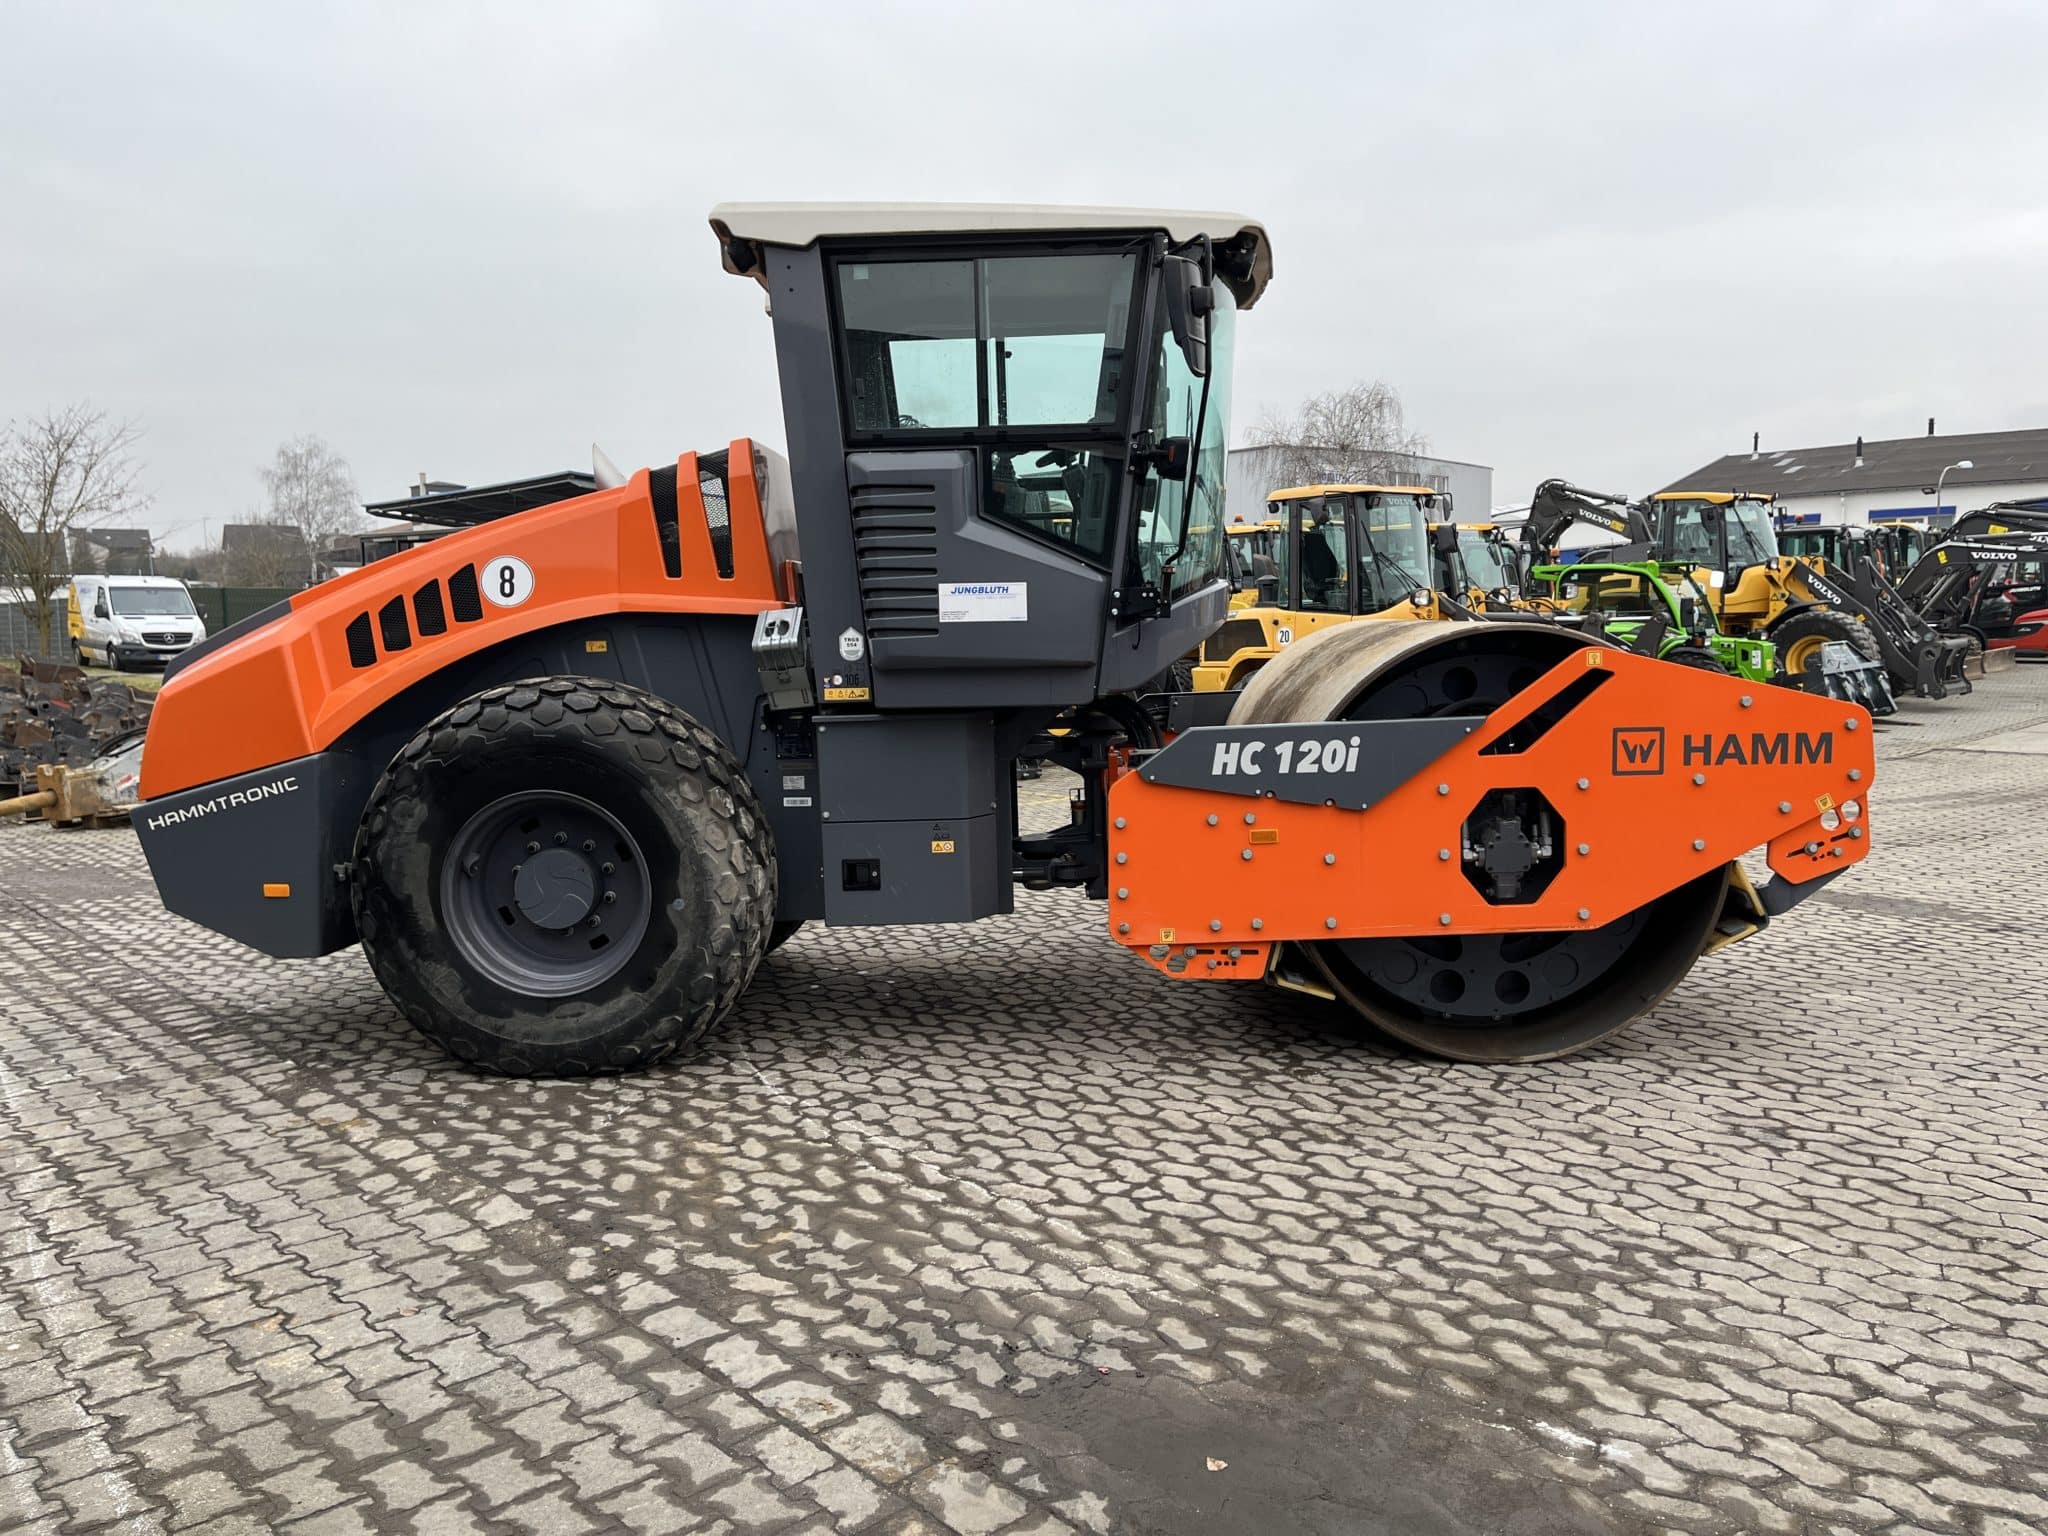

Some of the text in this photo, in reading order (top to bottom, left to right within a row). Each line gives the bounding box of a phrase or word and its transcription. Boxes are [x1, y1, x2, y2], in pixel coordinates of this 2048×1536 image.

[1579, 508, 1612, 526] VOLVO
[1970, 551, 2018, 560] VOLVO
[499, 565, 515, 598] 8
[950, 586, 1009, 594] JUNGBLUTH
[1807, 573, 1842, 605] VOLVO
[1279, 630, 1290, 643] 20
[1211, 735, 1361, 775] HC 120i
[1683, 732, 1833, 766] HAMM
[147, 777, 299, 830] HAMMTRONIC
